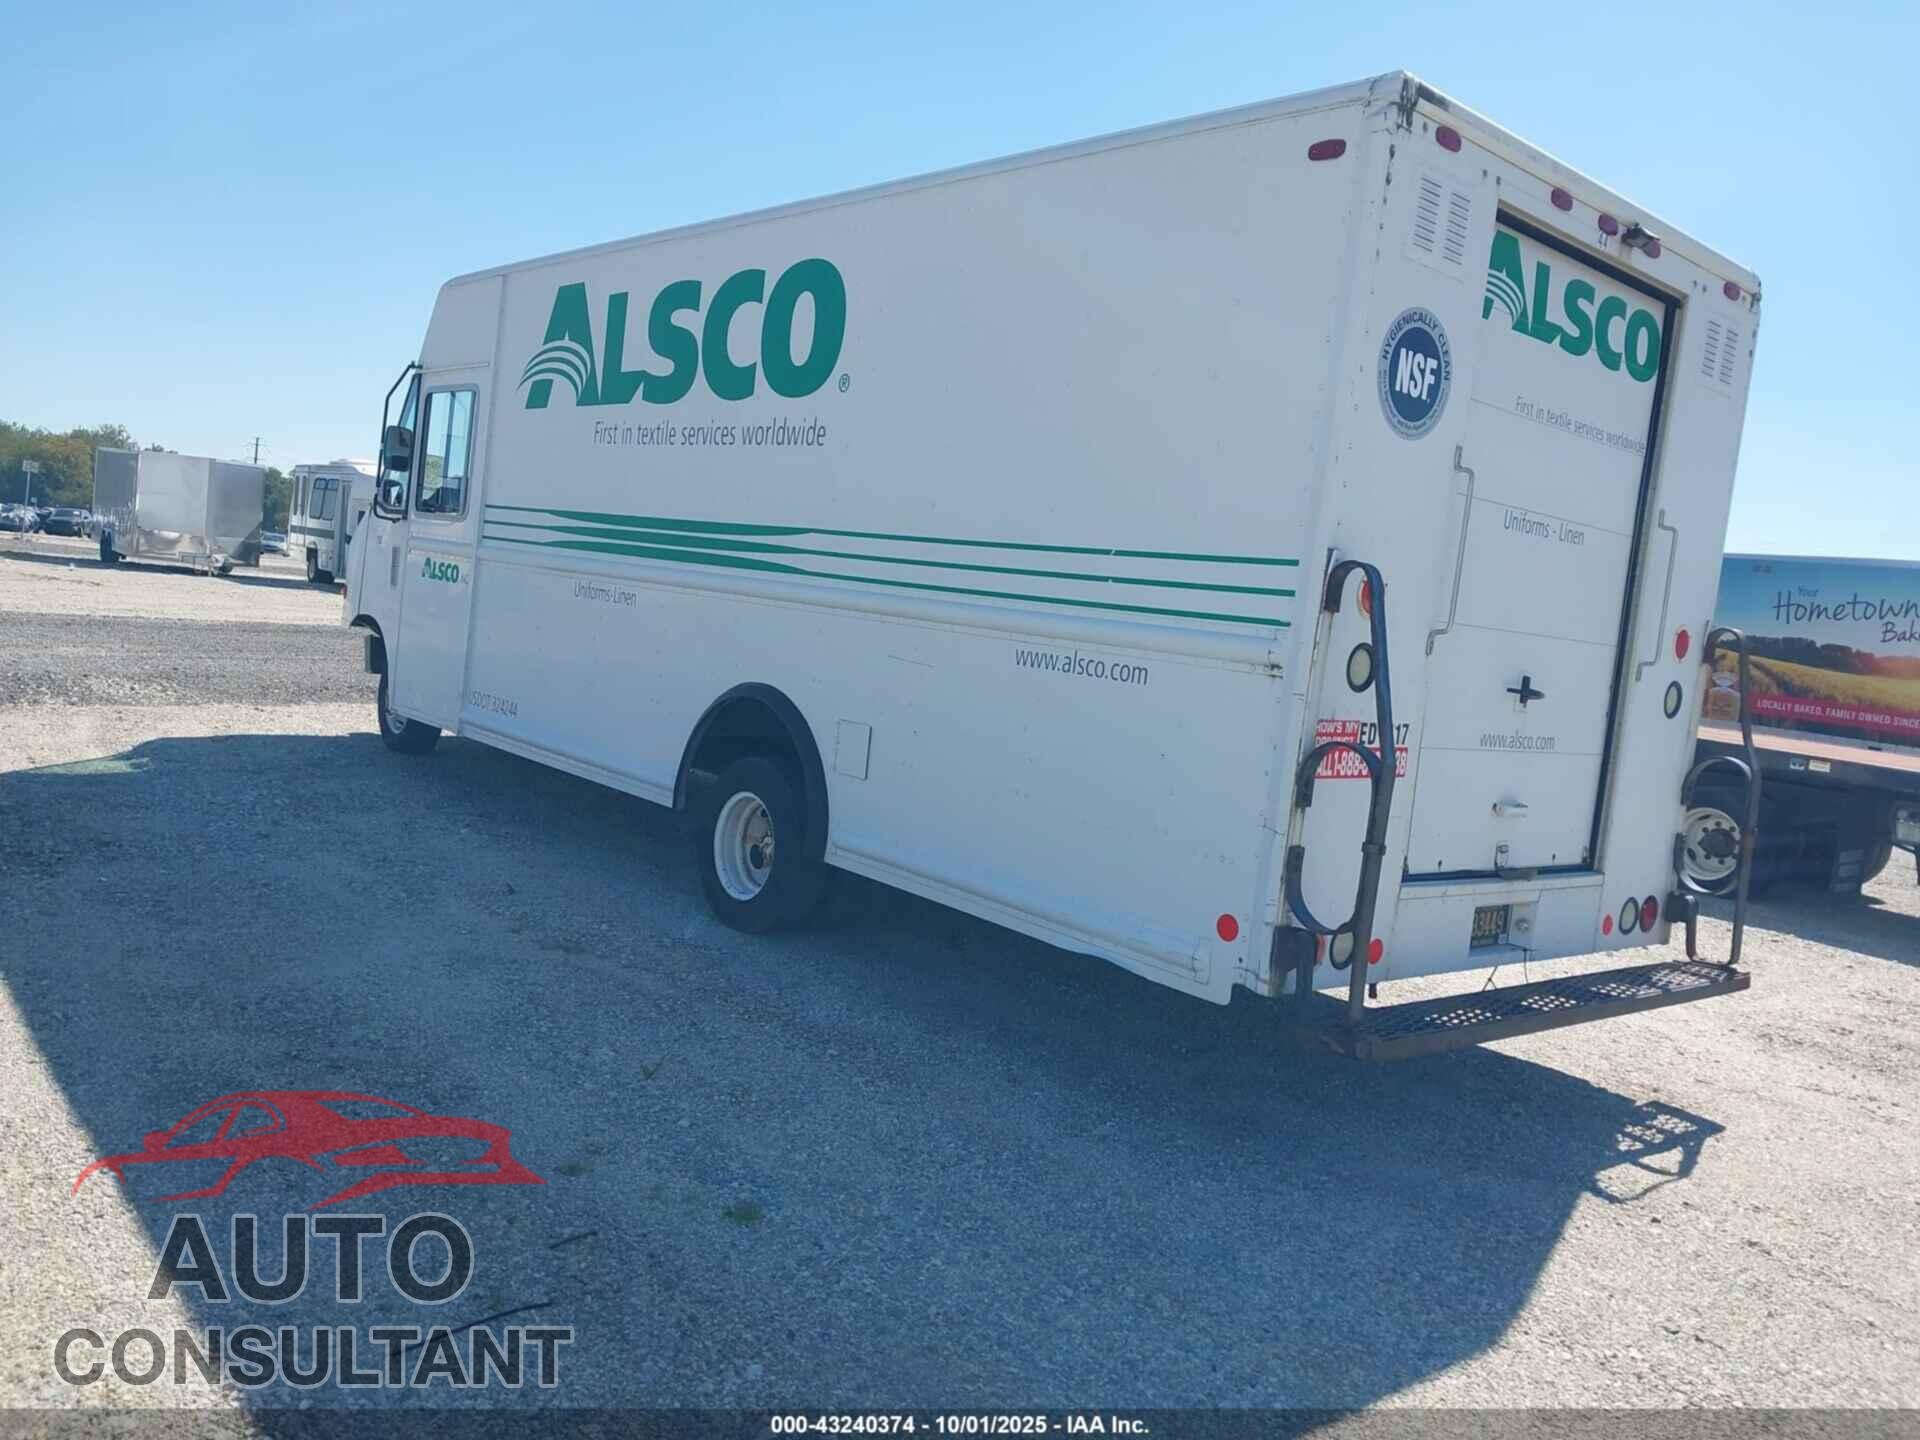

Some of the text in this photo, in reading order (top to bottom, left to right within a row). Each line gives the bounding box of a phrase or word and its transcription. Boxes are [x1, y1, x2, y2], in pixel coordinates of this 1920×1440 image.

[1481, 229, 1661, 382] ALSCO
[516, 258, 847, 409] ALSCO
[1395, 347, 1438, 401] NSF
[1515, 395, 1534, 417] First
[593, 416, 826, 447] First in textile services worldwide
[1503, 509, 1550, 538] Uniforms
[1558, 521, 1585, 545] Linen
[421, 556, 460, 584] ALSCO
[1772, 589, 1920, 625] Hometown
[1014, 648, 1149, 686] www.alsco.com
[1757, 699, 1792, 713] LOCALLY
[1825, 707, 1856, 721] FAMILY
[1858, 711, 1891, 724] OWNED
[1480, 729, 1556, 750] www.alsco.com
